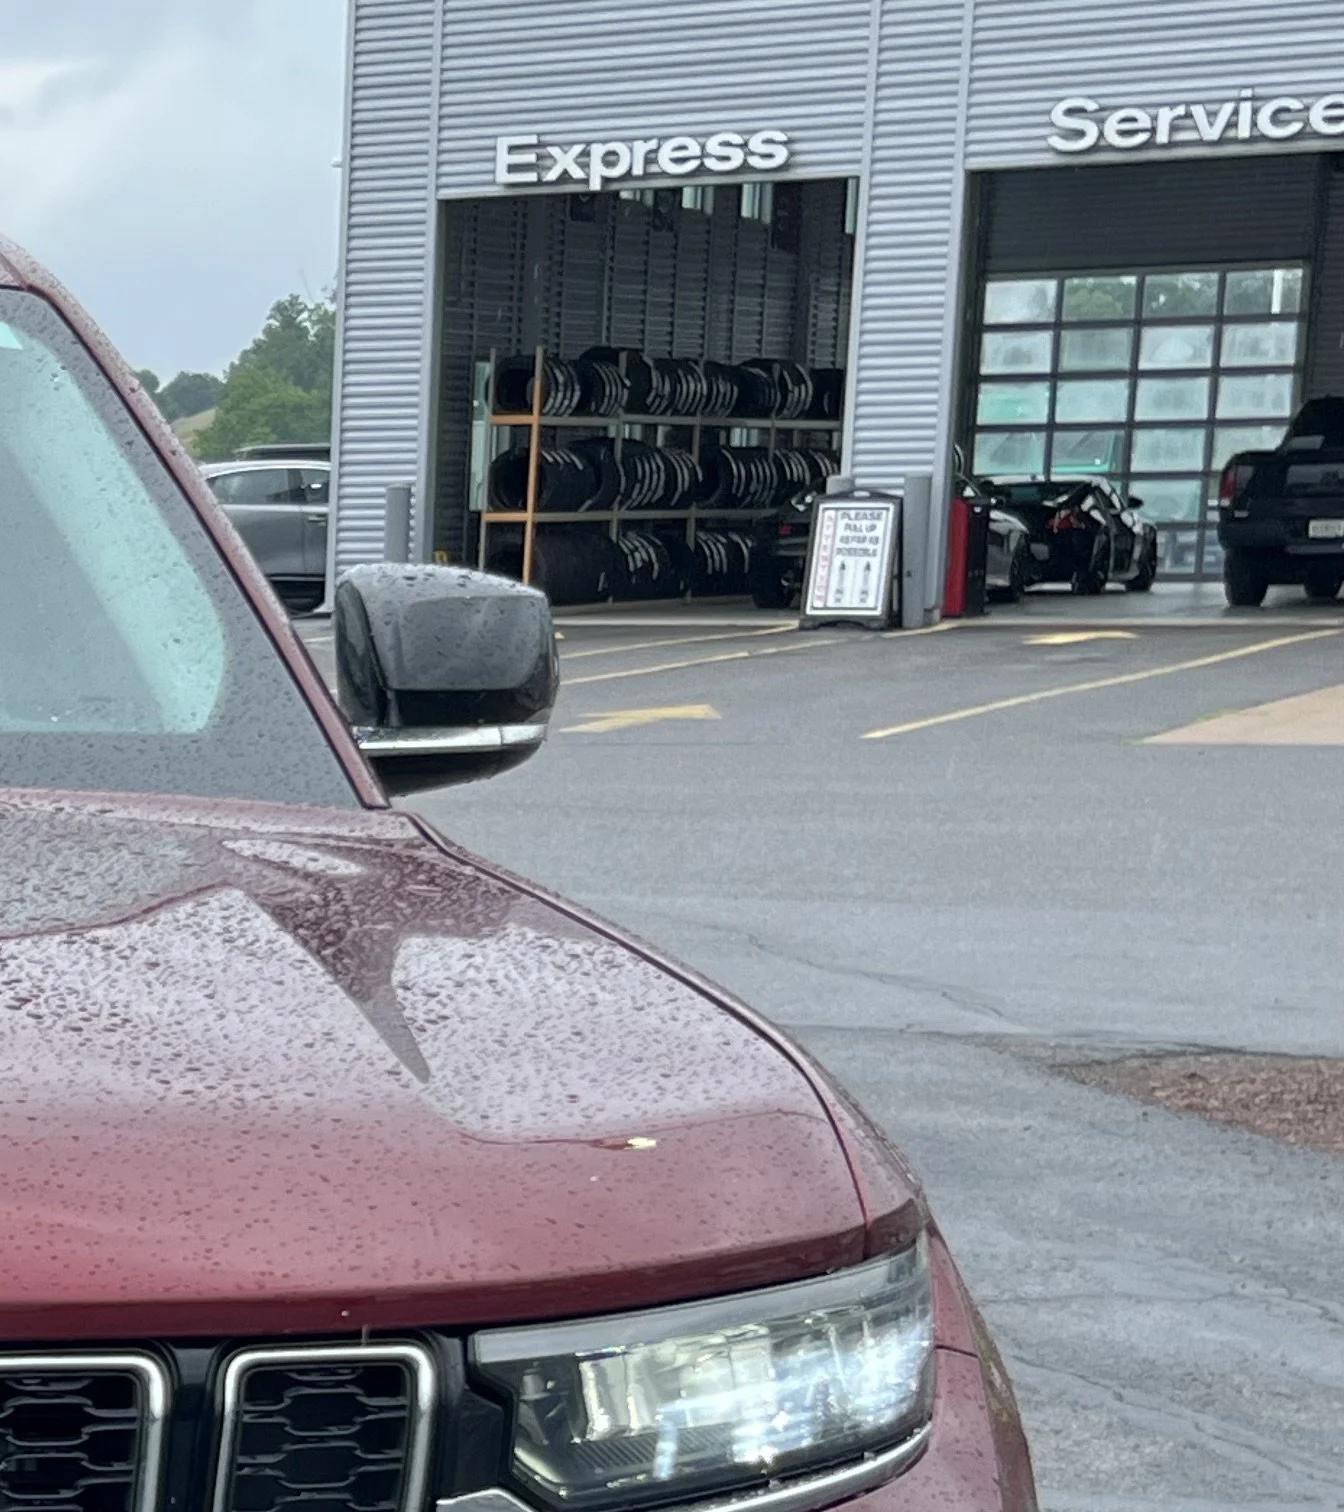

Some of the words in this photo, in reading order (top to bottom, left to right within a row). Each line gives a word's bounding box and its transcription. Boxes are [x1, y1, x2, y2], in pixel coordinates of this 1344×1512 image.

[1046, 87, 1344, 153] Service
[495, 129, 790, 191] Express
[840, 511, 883, 521] PLEASE
